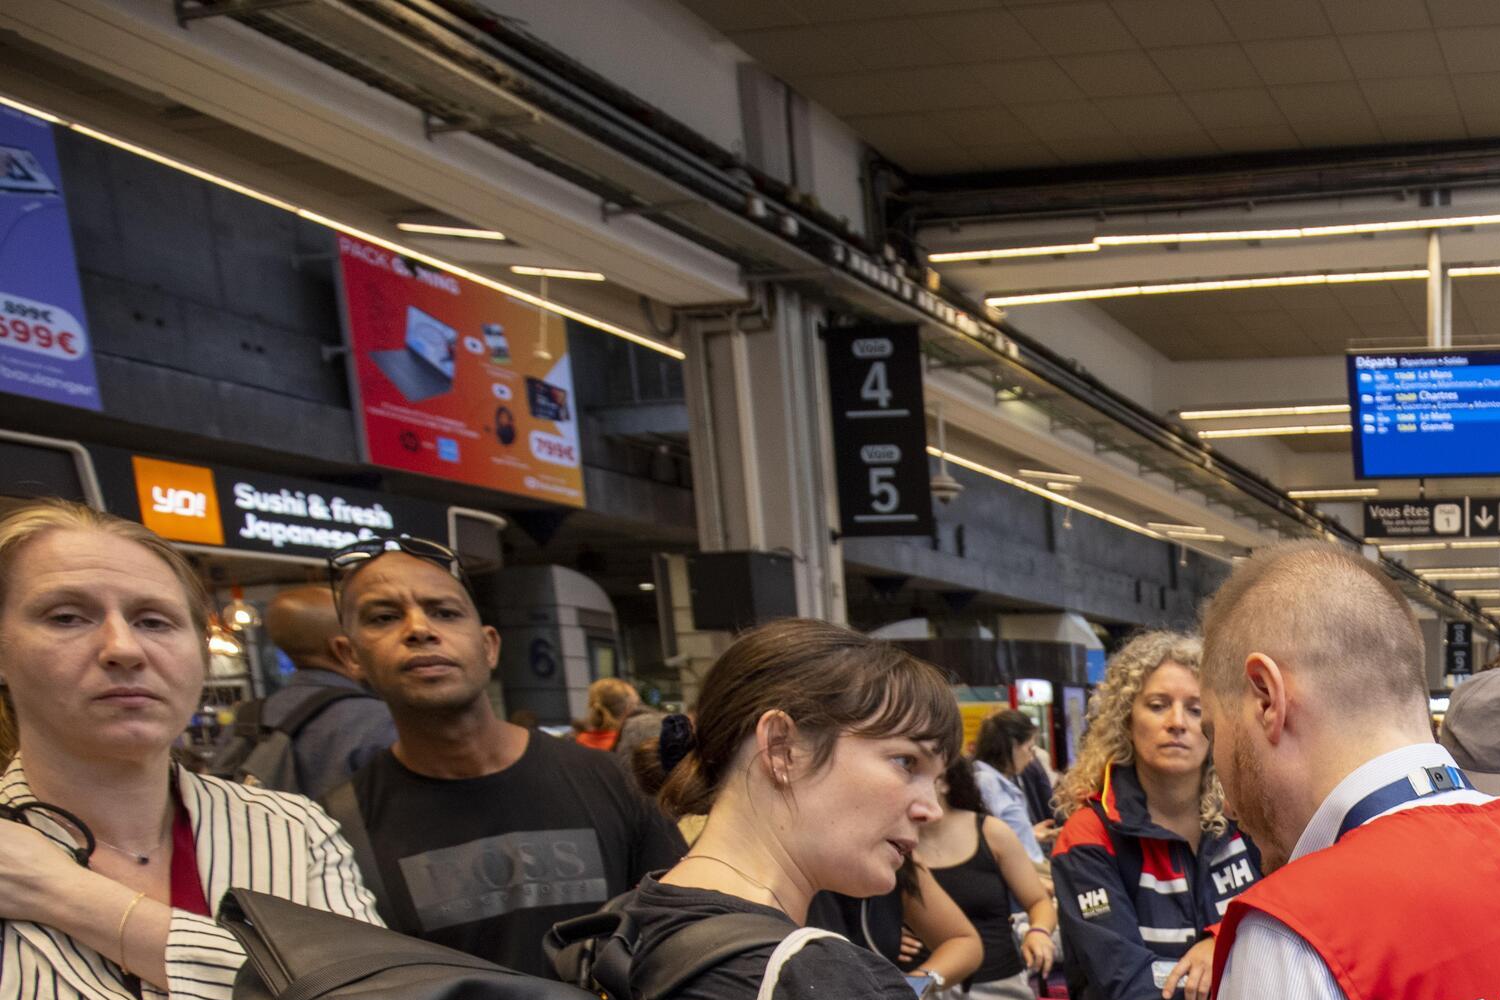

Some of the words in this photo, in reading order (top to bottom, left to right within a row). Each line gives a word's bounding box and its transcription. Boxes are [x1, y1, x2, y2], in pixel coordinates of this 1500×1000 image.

[339, 237, 388, 267] PACK
[858, 342, 886, 353] Voie
[1356, 356, 1397, 369] Départs
[1418, 371, 1428, 380] Le
[1430, 370, 1453, 380] Mans
[861, 361, 892, 408] 4
[1419, 390, 1458, 401] Chartres
[866, 447, 894, 460] Voie
[868, 467, 899, 513] 5
[234, 482, 307, 517] Sushi
[307, 494, 331, 521] &
[331, 497, 394, 529] fresh
[1369, 505, 1400, 518] Vous
[1403, 504, 1430, 517] êtes
[240, 513, 358, 550] Japanese
[1455, 630, 1464, 642] 8
[530, 638, 555, 678] 6
[1455, 656, 1465, 669] 9
[1211, 858, 1254, 895] HH
[1078, 888, 1109, 911] HH
